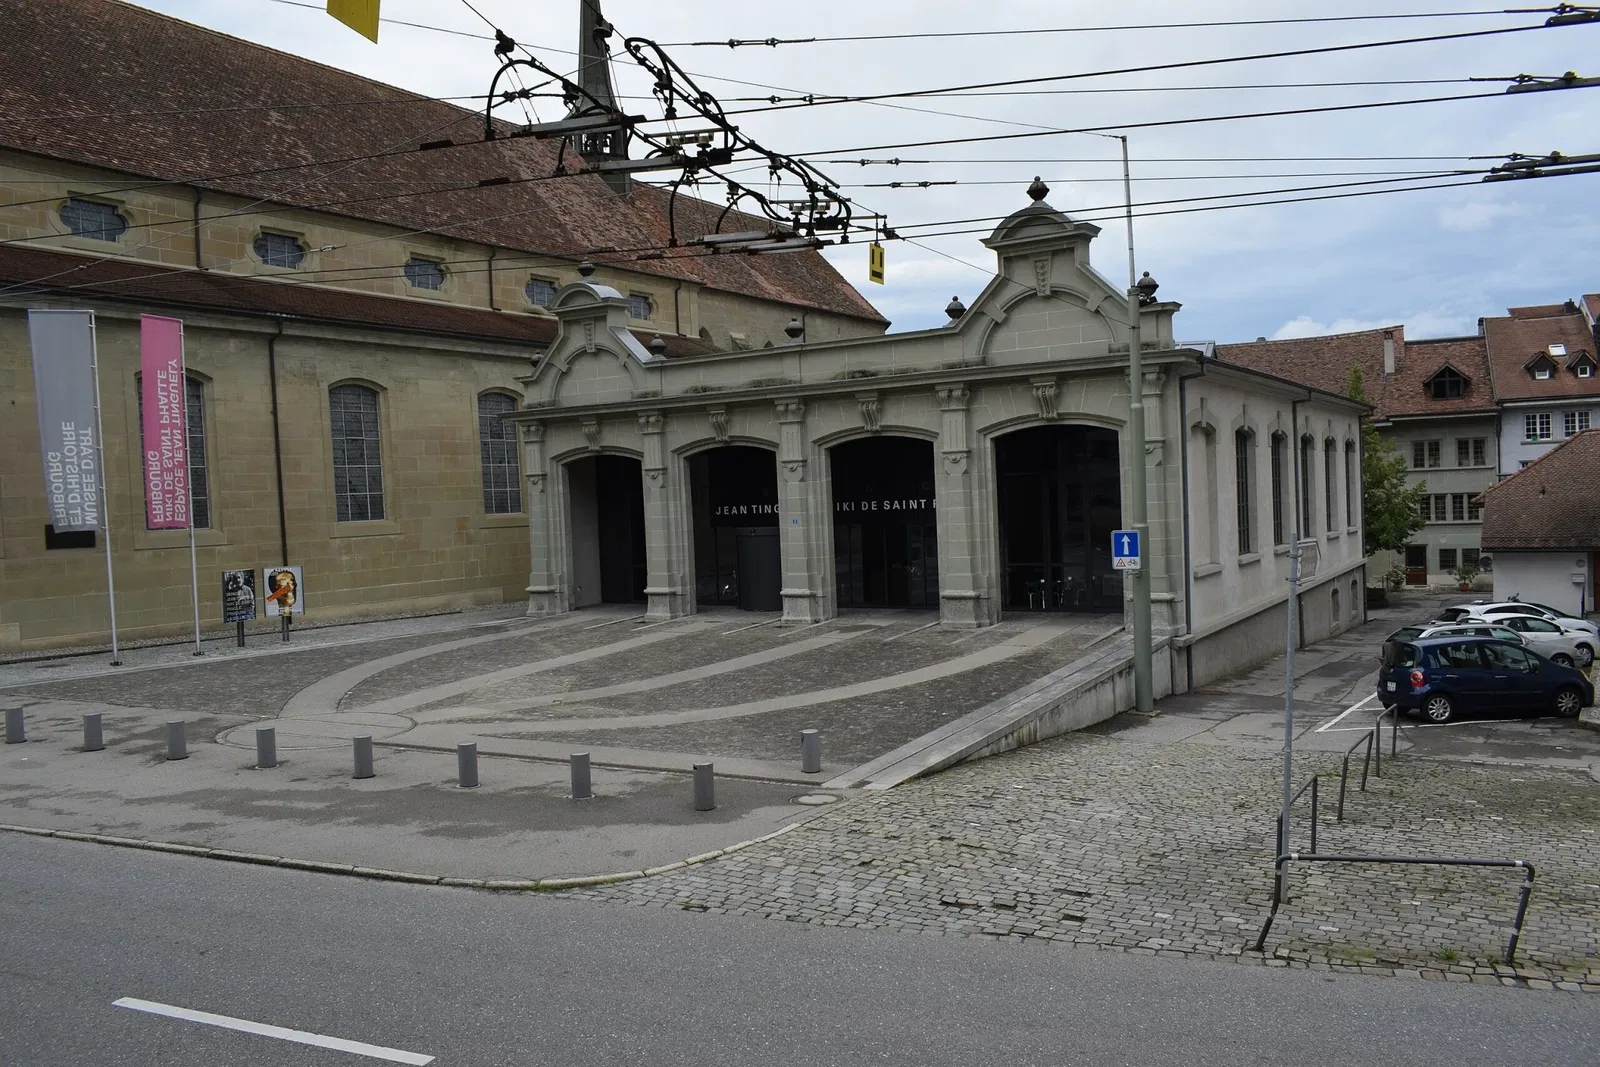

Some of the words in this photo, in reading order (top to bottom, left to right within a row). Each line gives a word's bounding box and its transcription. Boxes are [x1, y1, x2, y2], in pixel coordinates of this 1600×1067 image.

[715, 505, 747, 515] JEAN
[861, 501, 878, 511] DE
[883, 499, 927, 510] SAINT
